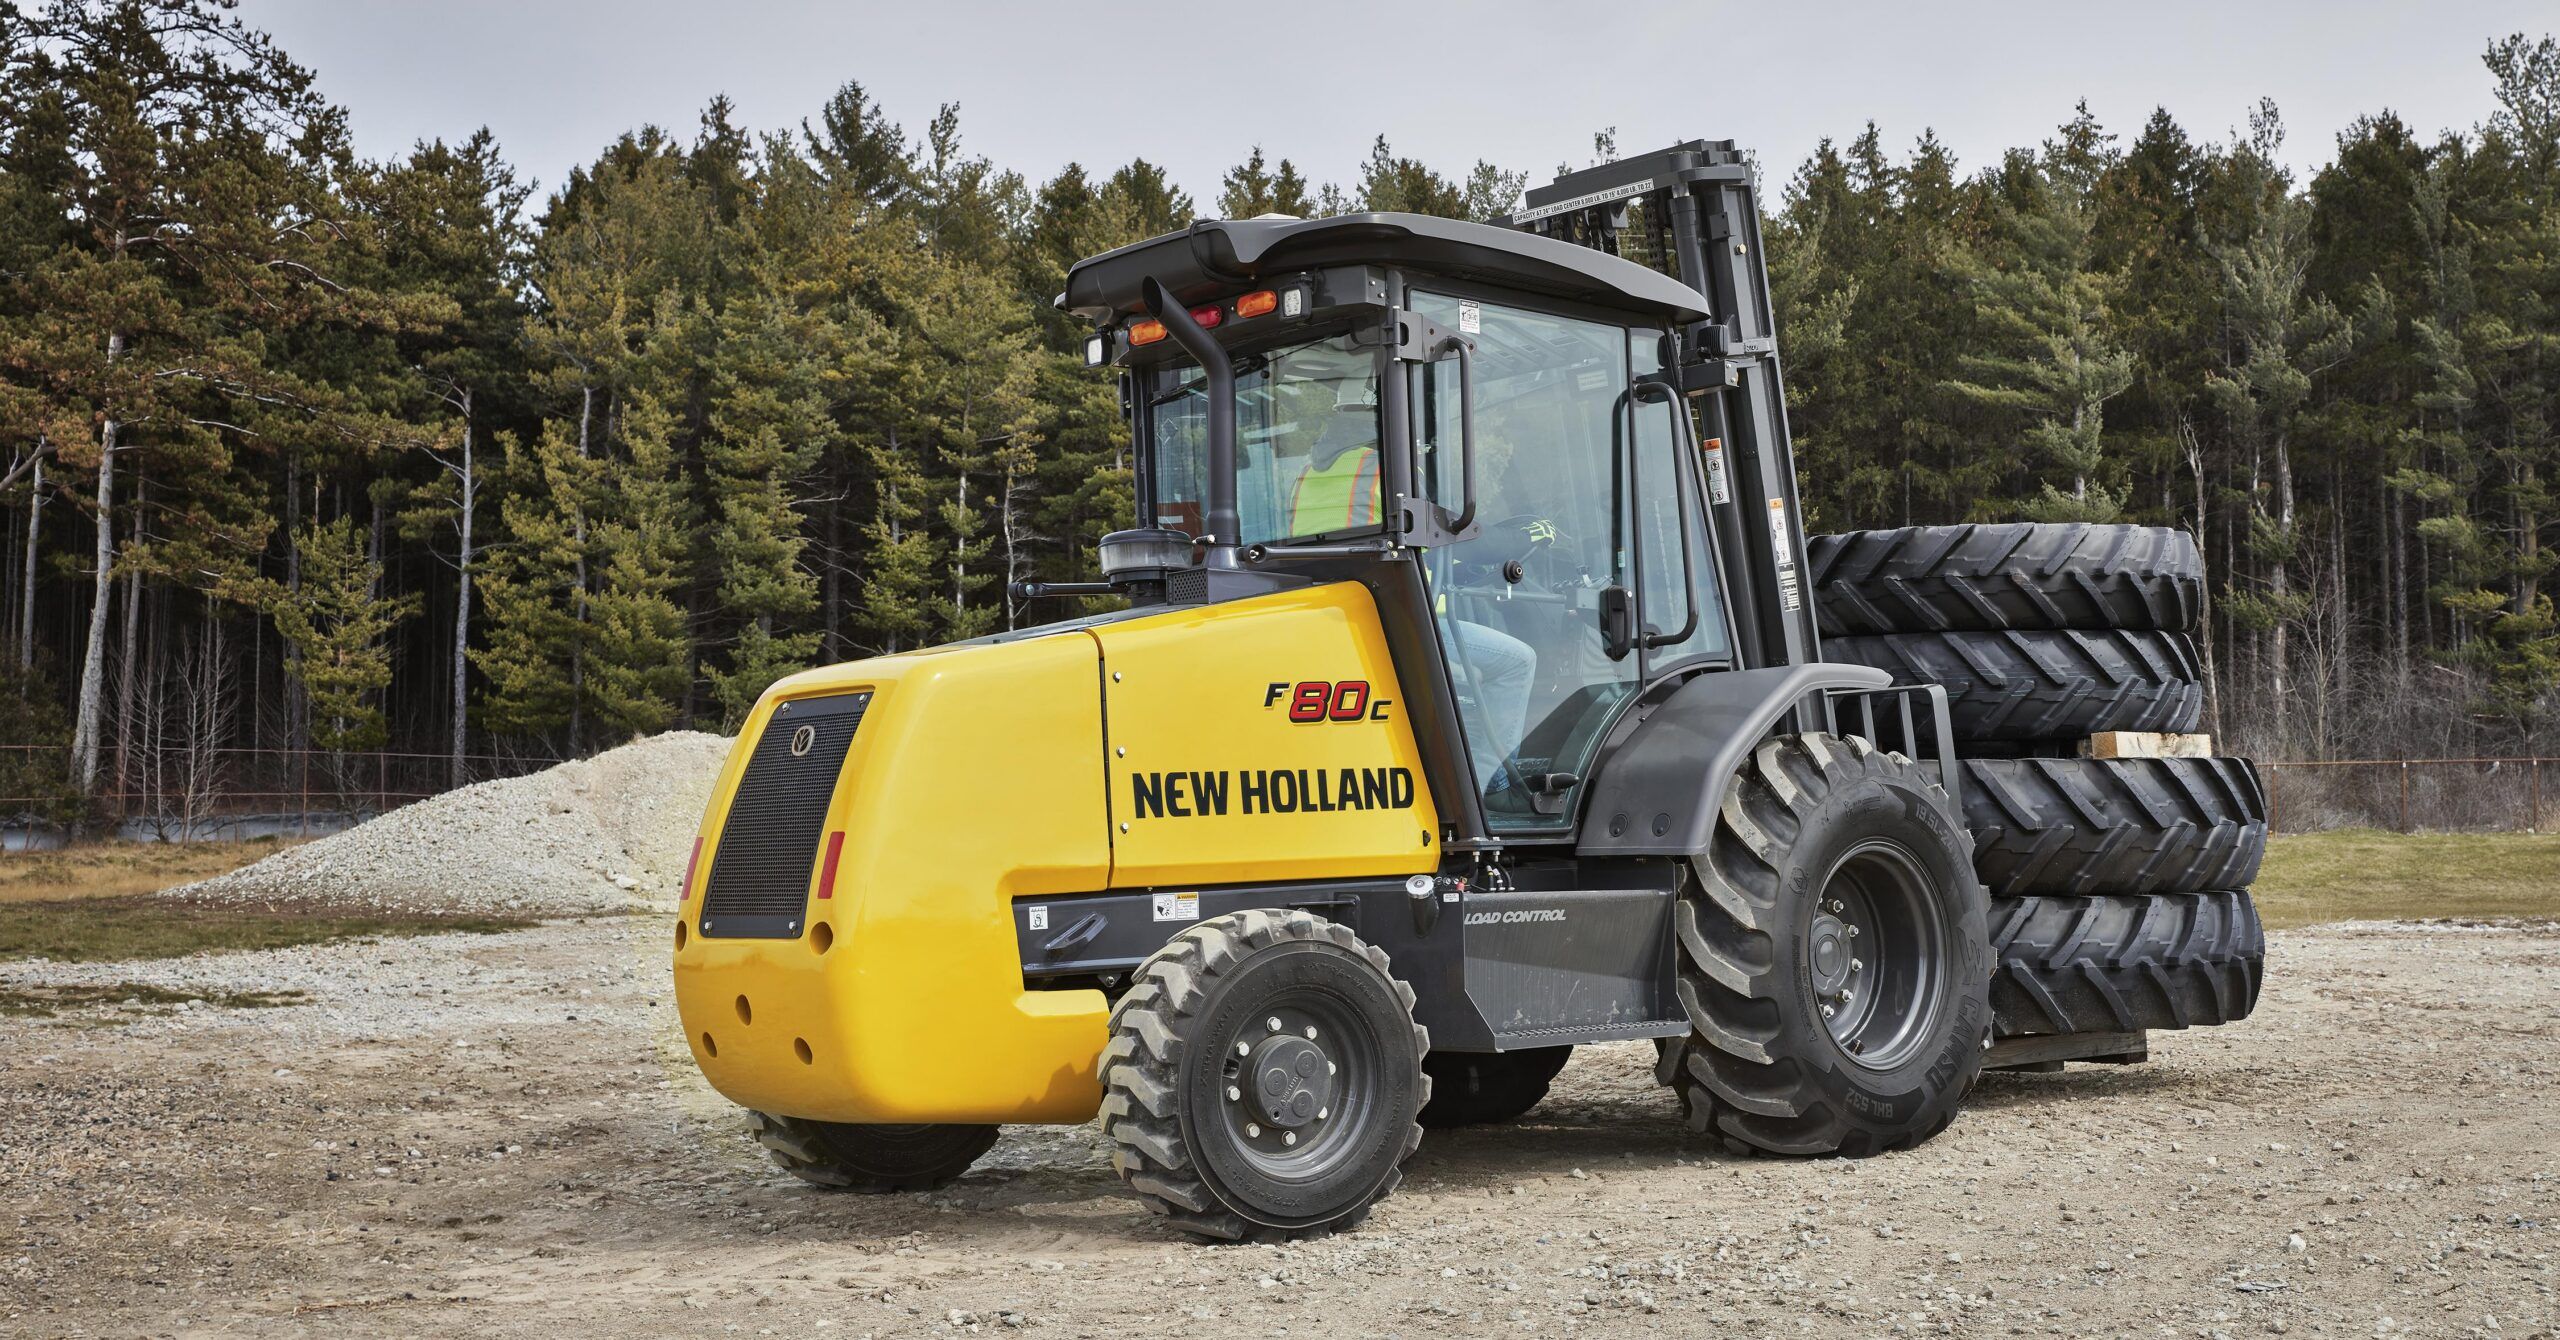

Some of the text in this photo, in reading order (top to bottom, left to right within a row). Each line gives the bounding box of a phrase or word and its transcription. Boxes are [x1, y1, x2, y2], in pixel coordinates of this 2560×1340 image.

[1514, 211, 1535, 222] CAPACITY
[1551, 204, 1563, 213] LOAD
[1564, 200, 1581, 210] CENTER
[1132, 767, 1415, 819] NEW HOLLAND
[1464, 909, 1566, 925] LOAD CONTROL
[1924, 995, 1981, 1096] CAMSO
[1844, 1087, 1894, 1119] BHL 532
